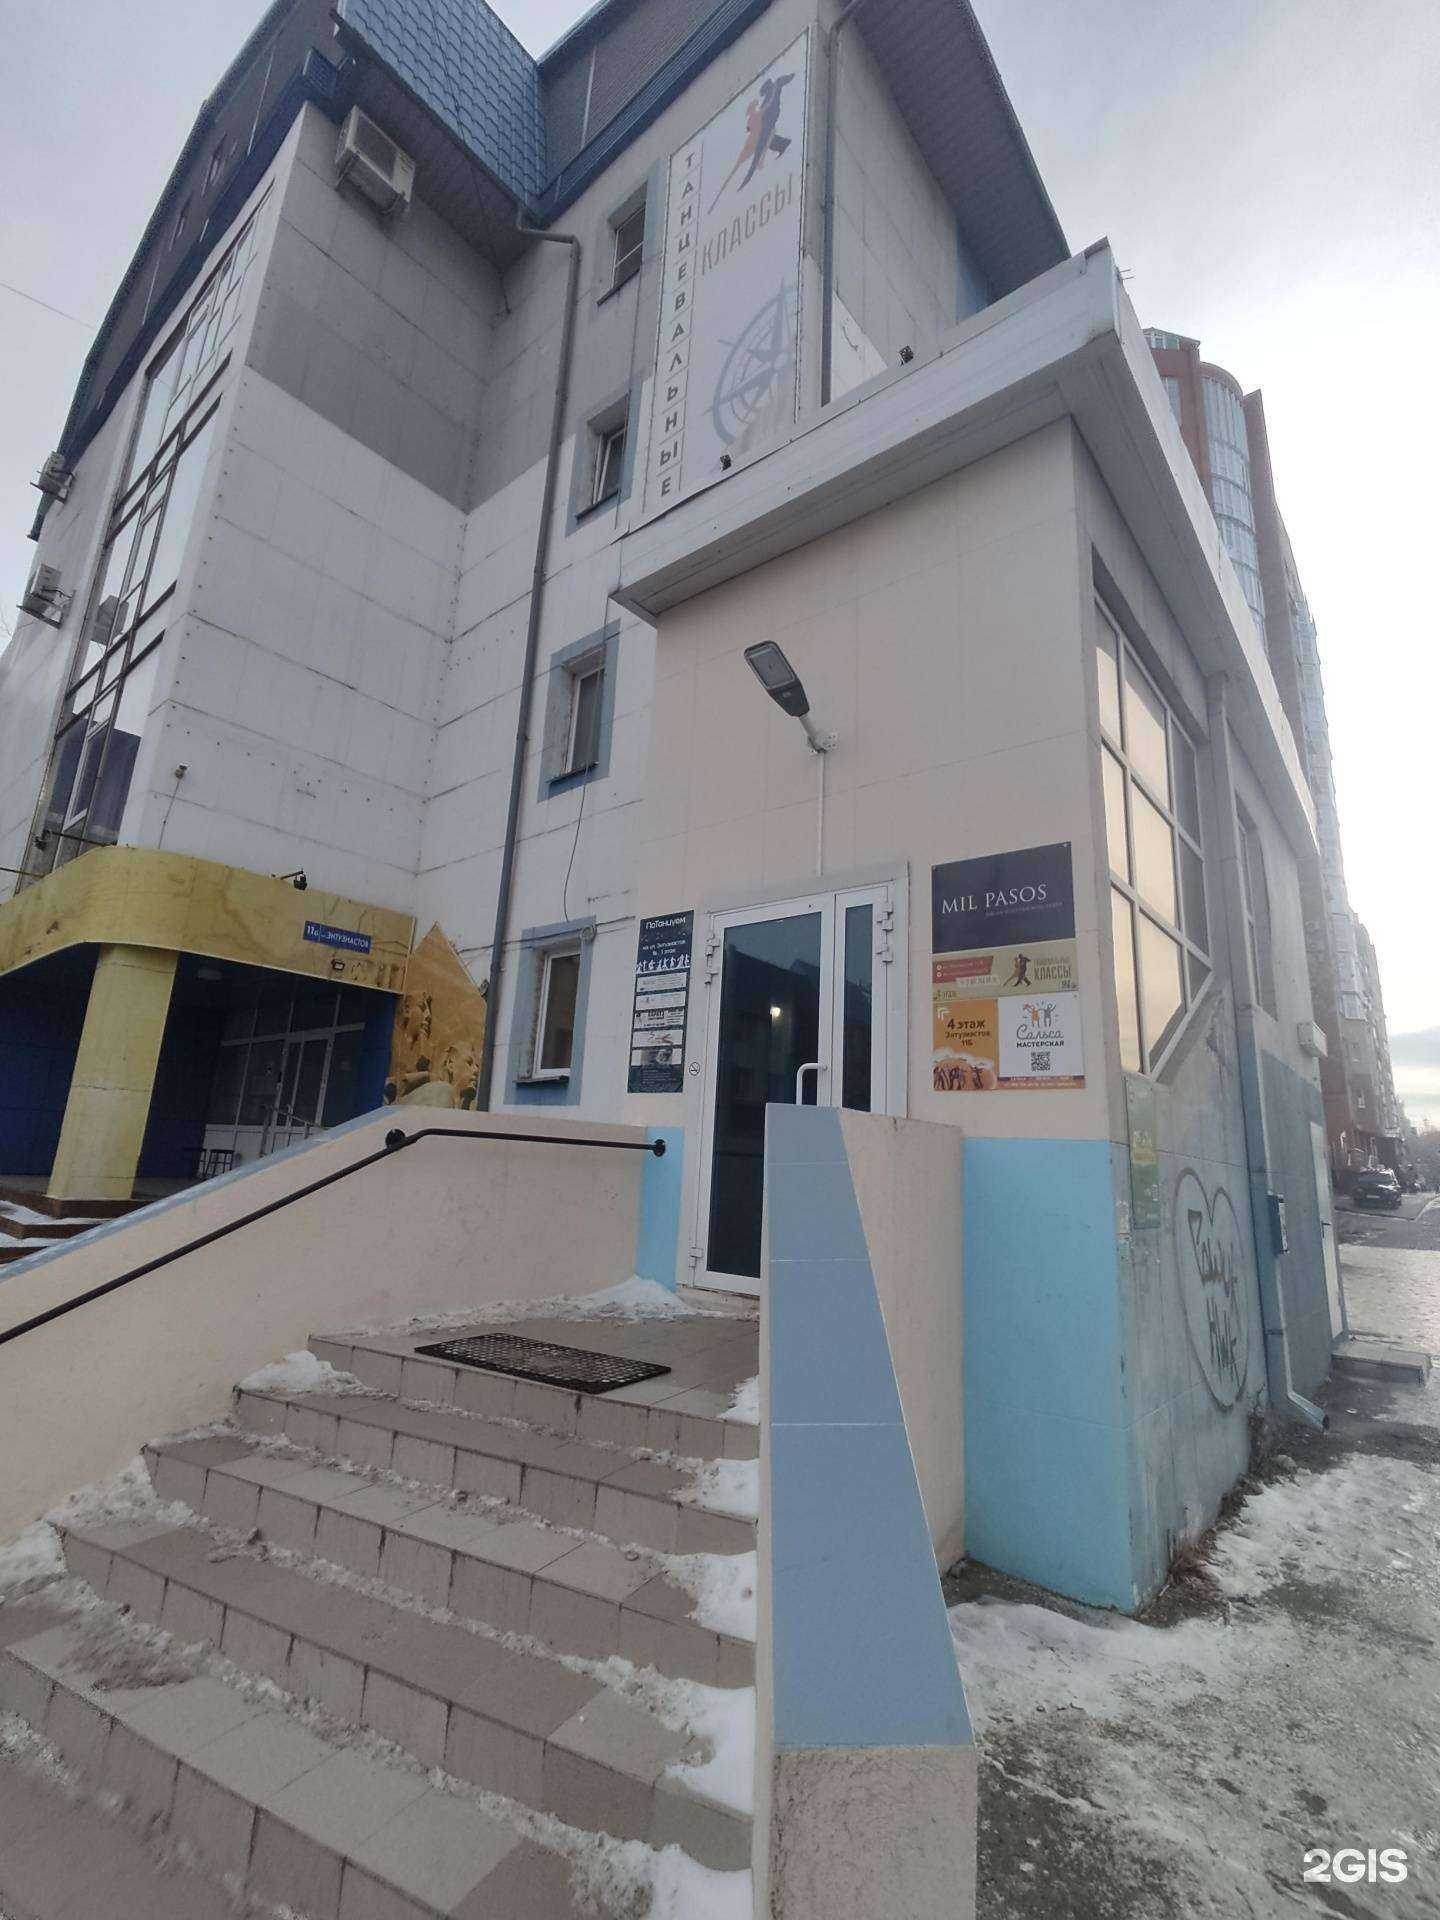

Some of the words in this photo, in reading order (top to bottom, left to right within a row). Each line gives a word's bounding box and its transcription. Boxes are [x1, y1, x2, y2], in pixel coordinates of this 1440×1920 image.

[701, 173, 794, 276] КЛАССЫ
[659, 151, 696, 497] ТАНЦЕВАЛЬНЫЕ
[942, 894, 978, 914] MIL
[985, 883, 1048, 908] PASOS
[947, 1018, 956, 1030] 4
[957, 1018, 986, 1030] этаж
[1016, 1024, 1064, 1041] Сальса
[1016, 1040, 1065, 1049] МАСТЕРСКАЯ
